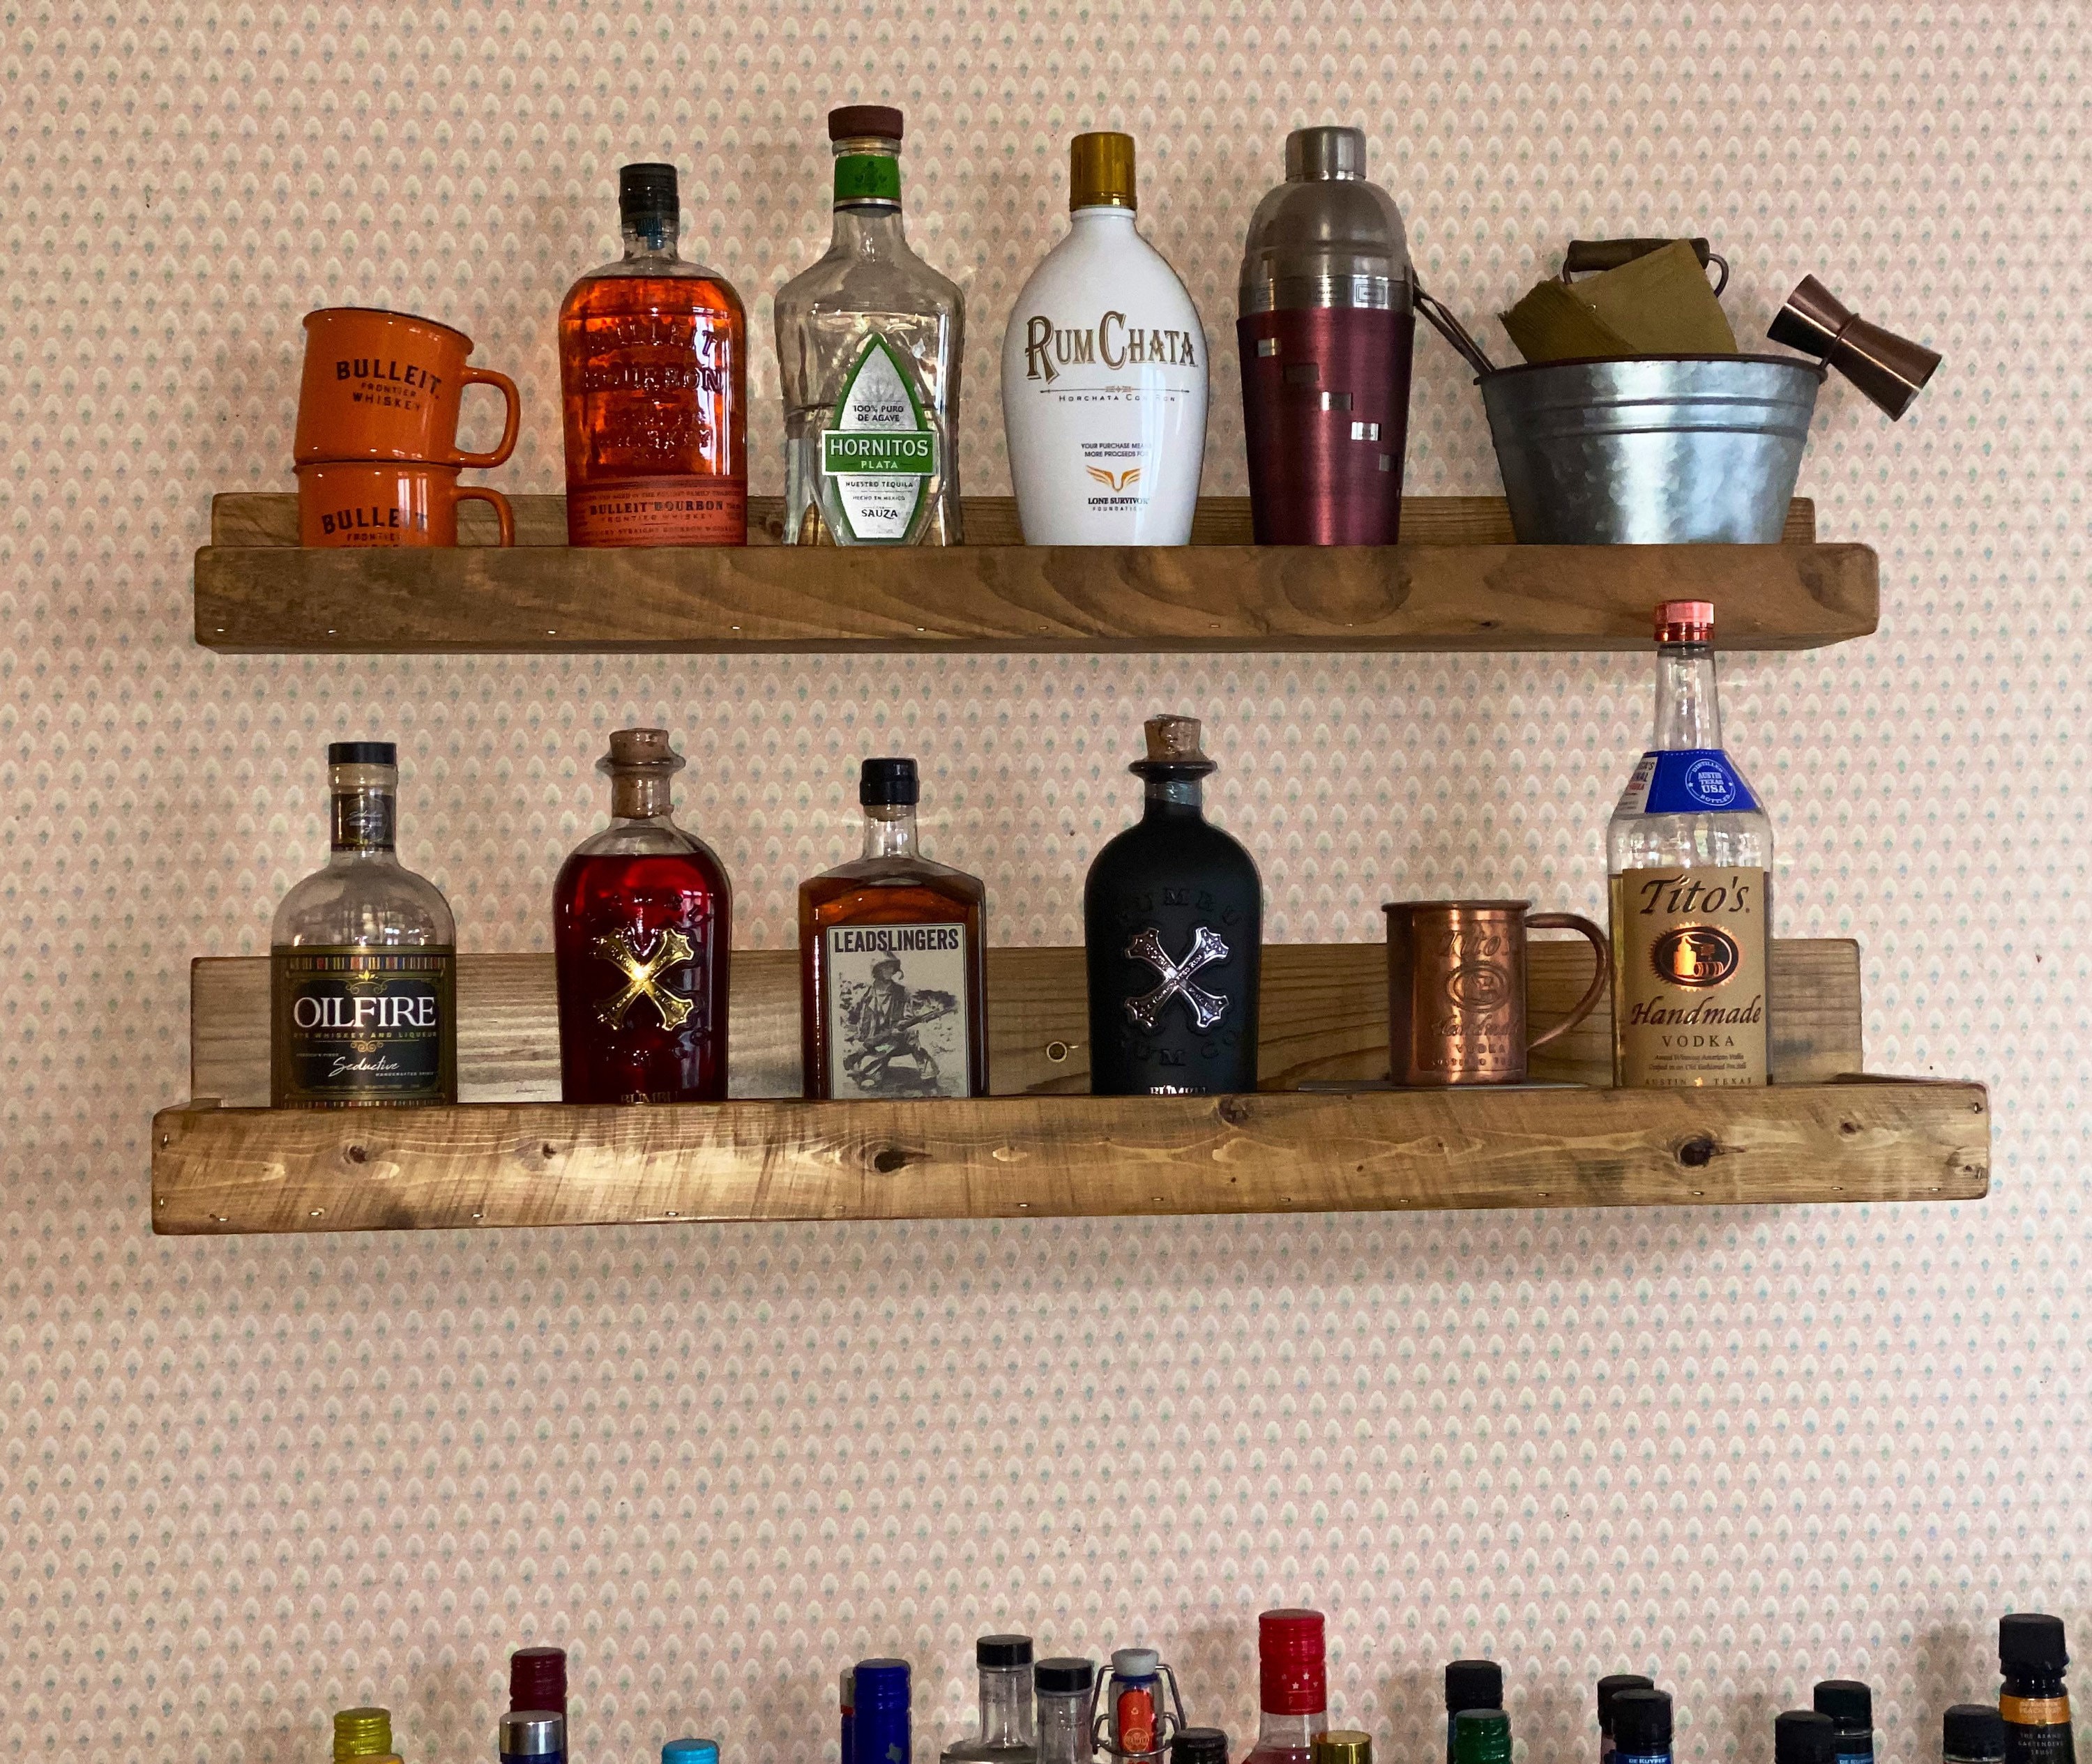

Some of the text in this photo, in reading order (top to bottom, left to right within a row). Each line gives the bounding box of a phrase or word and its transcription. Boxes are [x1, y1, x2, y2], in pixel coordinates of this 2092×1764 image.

[336, 358, 441, 395] BULLEIT
[361, 382, 416, 397] FRONTIER
[352, 391, 420, 411] WHISKEY
[1125, 393, 1148, 402] CO
[830, 439, 929, 457] HORNITOS
[861, 459, 899, 469] PLATA
[589, 501, 648, 516] BULLEIT
[654, 501, 723, 512] BOURBON
[861, 508, 898, 520] SAUZA
[1701, 784, 1727, 793] USA
[1699, 793, 1731, 804] BOTTLED
[1639, 873, 1750, 915] Tito's
[833, 928, 960, 953] LEADSLINGERS
[293, 996, 437, 1028] OILFIRE
[1630, 994, 1762, 1026] Handmade
[397, 1031, 437, 1039] LIQUEUR
[1661, 1034, 1735, 1048] VODKA
[328, 1055, 400, 1078] Seductive
[1713, 1077, 1752, 1086] TEXAS
